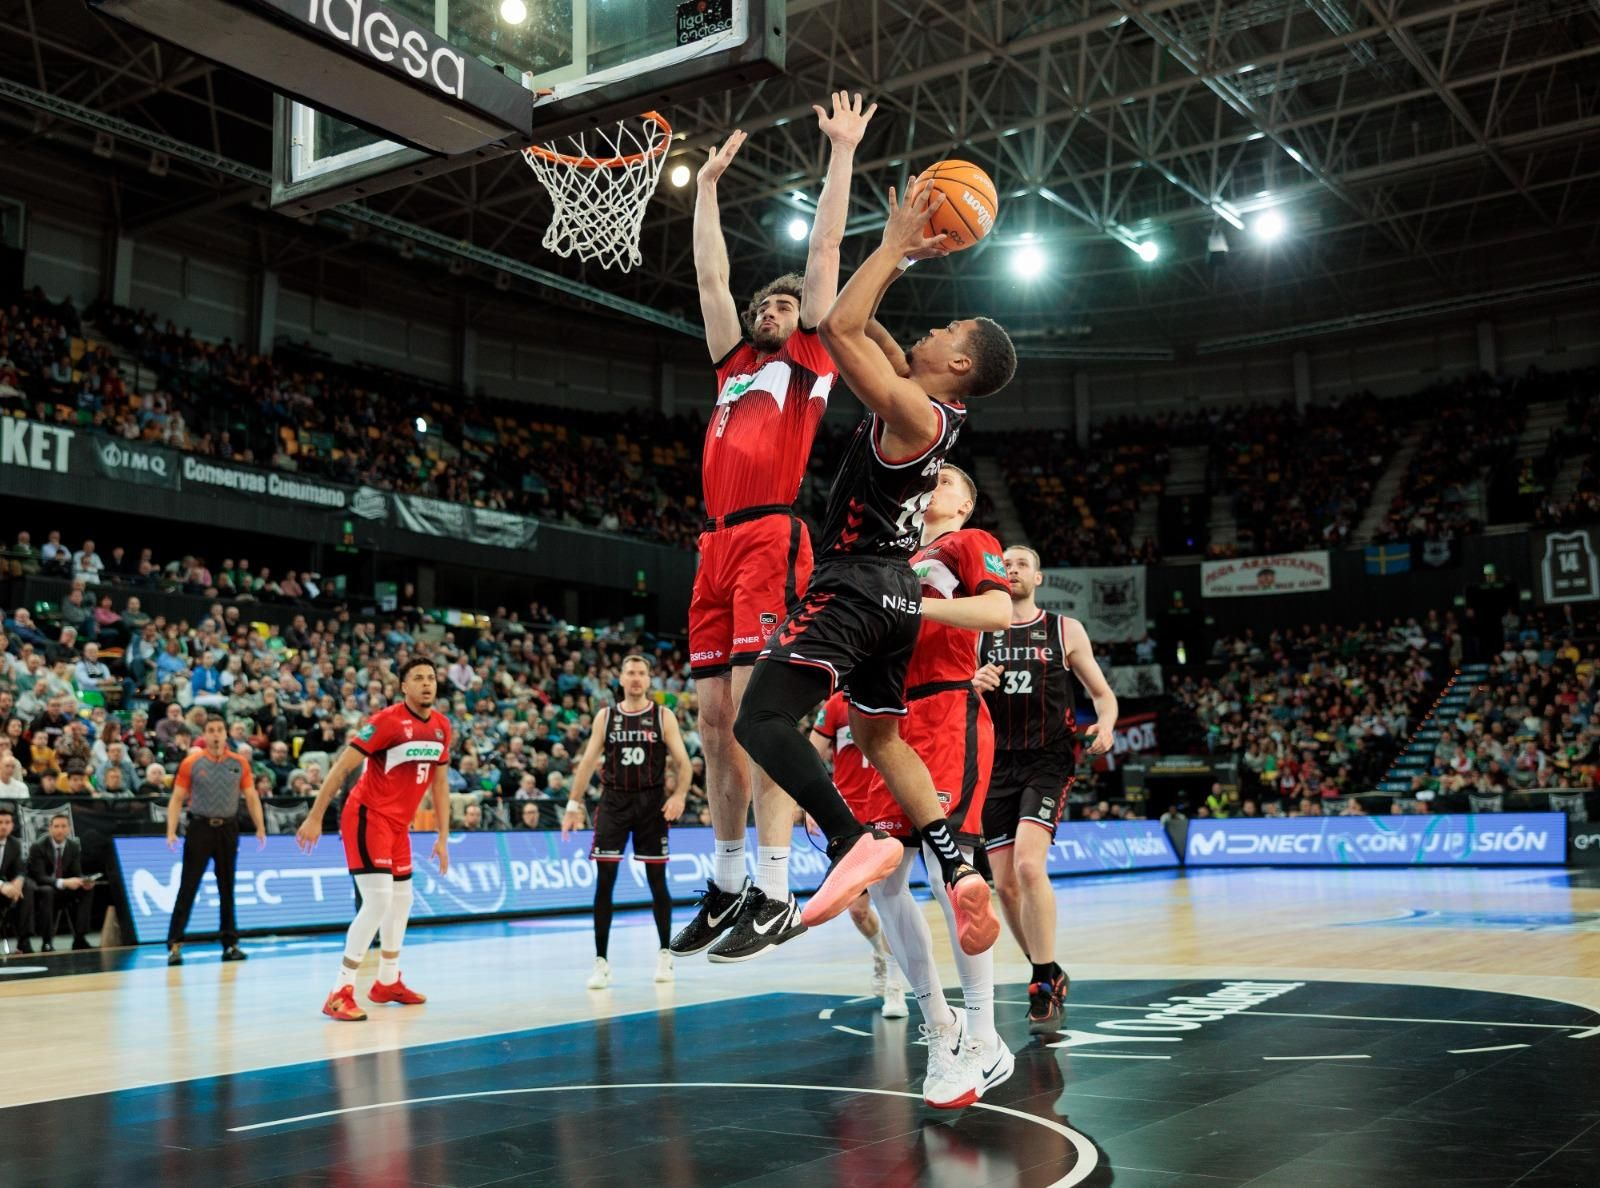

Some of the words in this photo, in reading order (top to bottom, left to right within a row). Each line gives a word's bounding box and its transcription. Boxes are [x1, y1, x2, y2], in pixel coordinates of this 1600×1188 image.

[680, 12, 704, 30] liga
[309, 0, 465, 99] desa
[2, 416, 75, 473] KET
[122, 451, 168, 476] IMQ
[184, 456, 266, 493] Conservas
[268, 473, 345, 508] Cusumano
[987, 646, 1053, 664] surne
[1003, 670, 1032, 694] 32
[609, 730, 658, 743] surne
[621, 747, 645, 766] 30
[1443, 824, 1548, 851] PSIÓN
[510, 848, 597, 890] PASIÓ
